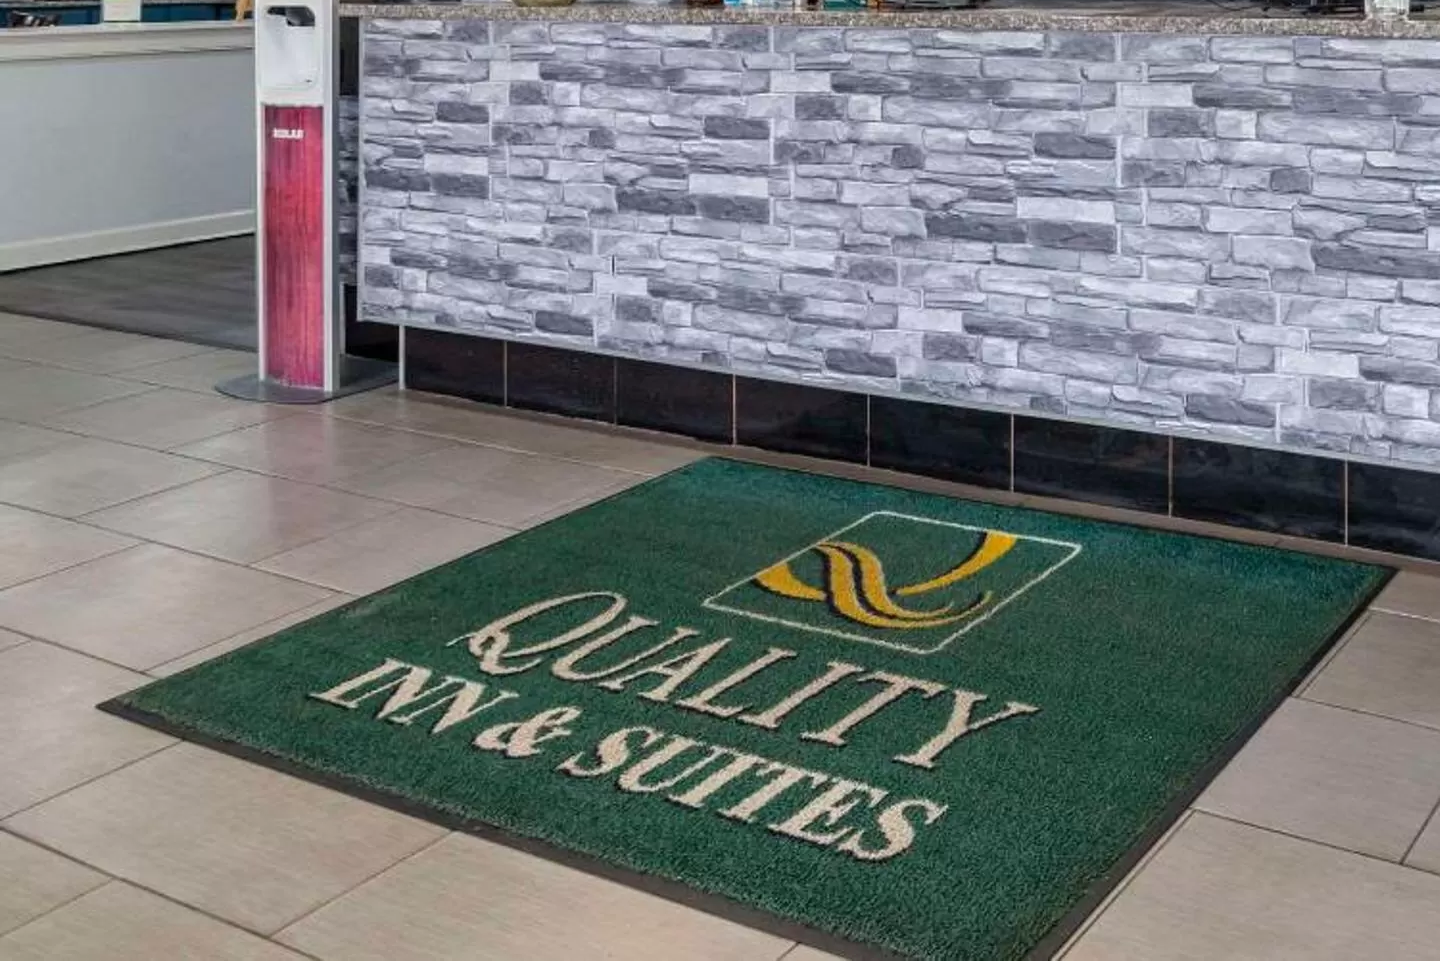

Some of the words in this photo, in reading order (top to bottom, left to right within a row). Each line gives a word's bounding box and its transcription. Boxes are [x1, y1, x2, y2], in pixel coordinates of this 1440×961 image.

[309, 657, 520, 735] INN
[472, 705, 583, 758] &
[556, 725, 949, 861] SUITES
[446, 590, 1040, 769] QUALITY
